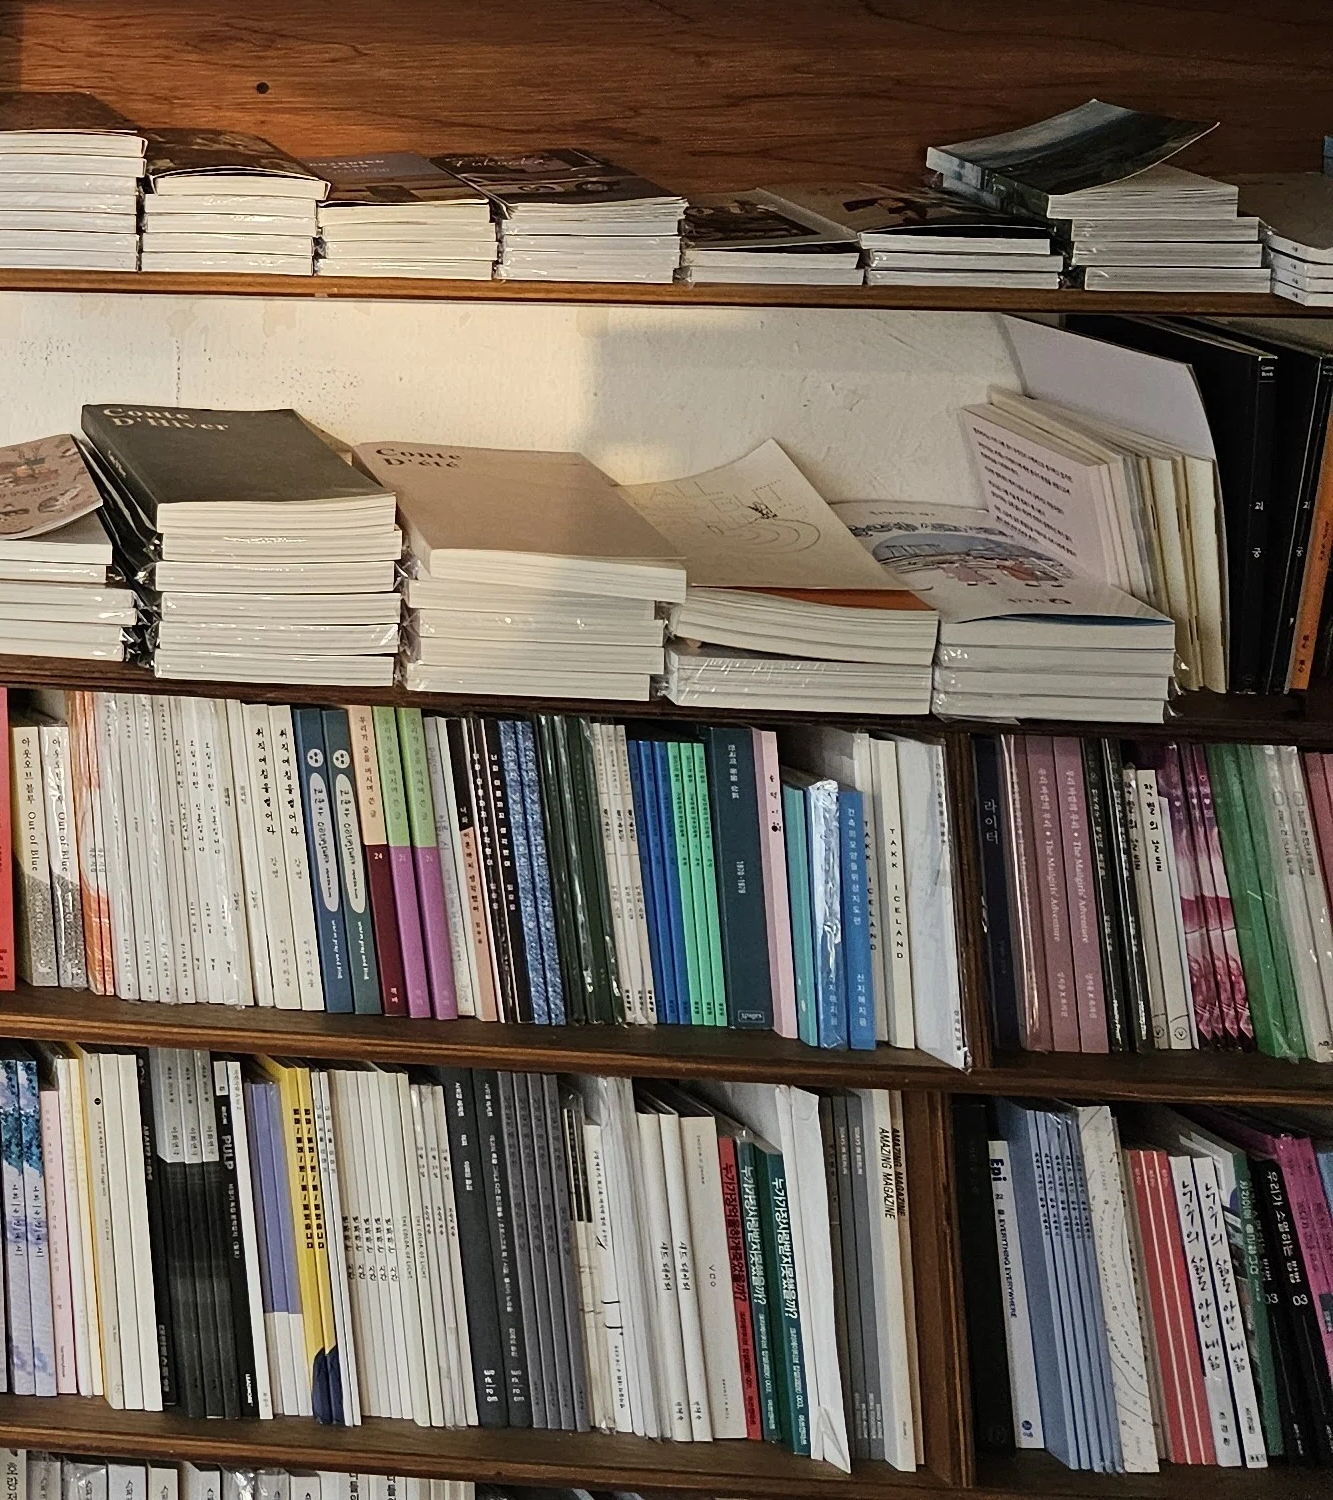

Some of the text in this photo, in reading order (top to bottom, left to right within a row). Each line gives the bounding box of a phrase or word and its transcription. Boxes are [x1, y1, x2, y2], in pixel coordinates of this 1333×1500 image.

[103, 407, 191, 423] Conte
[112, 417, 231, 432] D'Hiver
[375, 447, 461, 461] Conte
[28, 812, 36, 831] Out
[29, 832, 38, 846] of
[31, 849, 40, 871] Blue
[890, 828, 904, 959] TAKK ICELAND
[879, 1127, 897, 1220] AMAZING MAGAZINE
[990, 1158, 1007, 1182] Epi
[1267, 1172, 1283, 1206] 우리가
[1287, 1261, 1301, 1284] 방법
[1293, 1295, 1308, 1306] 03
